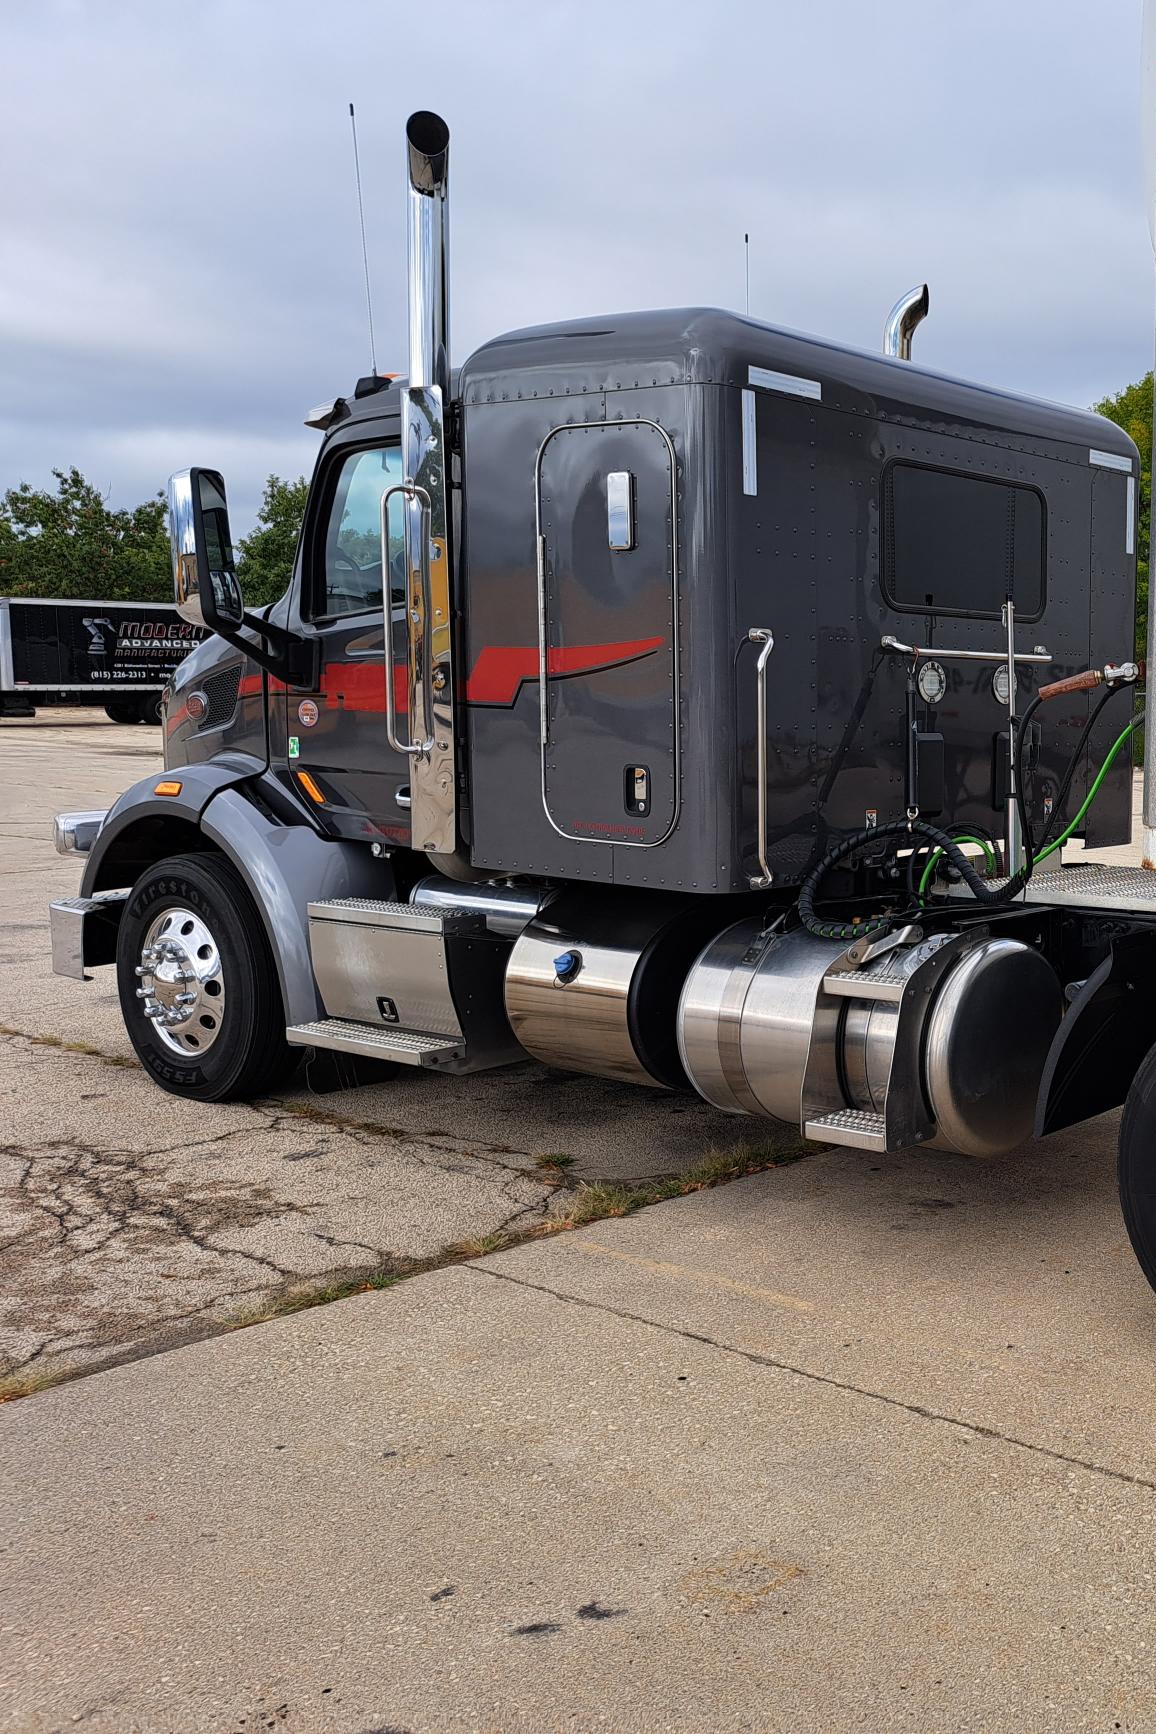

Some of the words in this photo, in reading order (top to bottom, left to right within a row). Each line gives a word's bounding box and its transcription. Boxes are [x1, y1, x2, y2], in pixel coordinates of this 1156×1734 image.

[121, 639, 200, 648] ADVANCED
[114, 649, 192, 657] MANUFACTURI
[90, 670, 111, 680] (815)
[112, 670, 146, 679] 226-2313
